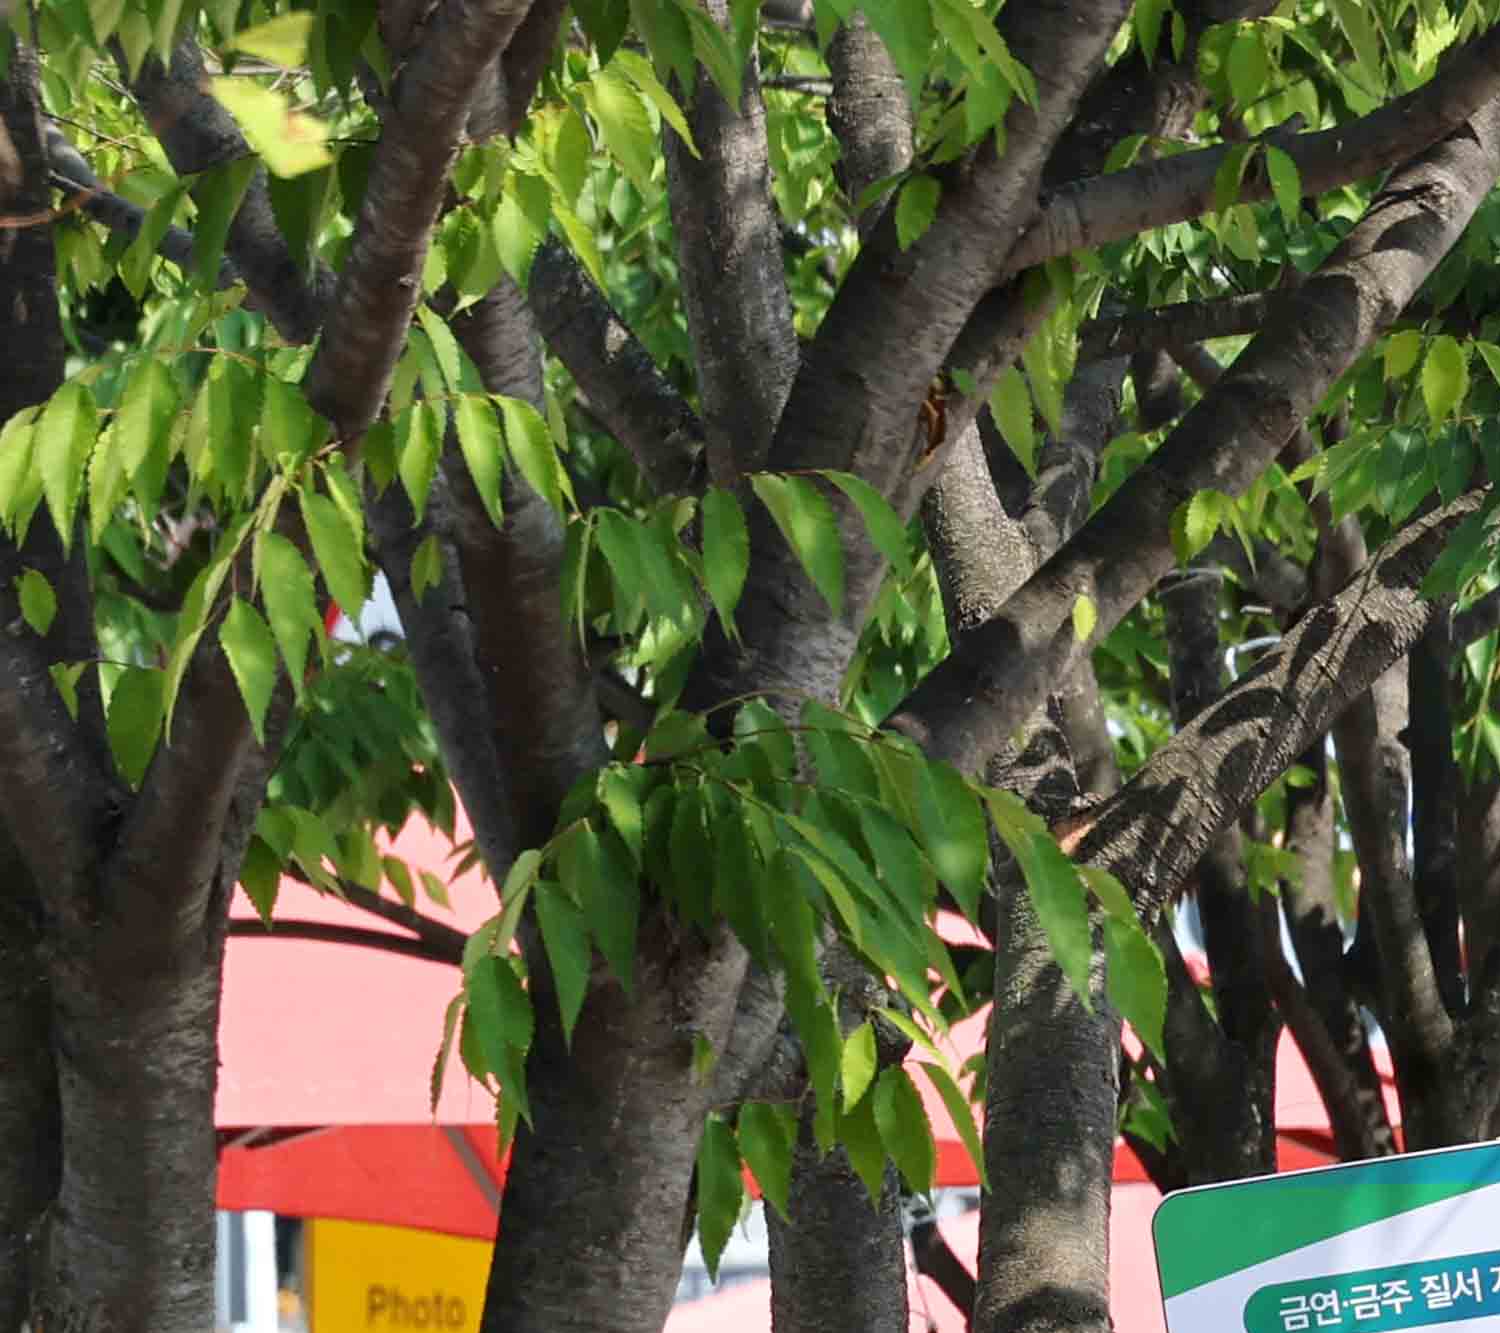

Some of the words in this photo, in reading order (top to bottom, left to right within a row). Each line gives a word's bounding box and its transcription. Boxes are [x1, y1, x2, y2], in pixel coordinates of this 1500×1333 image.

[368, 1284, 466, 1330] Photo
[1279, 1283, 1412, 1332] 금연·금주
[1421, 1269, 1482, 1309] 질서
